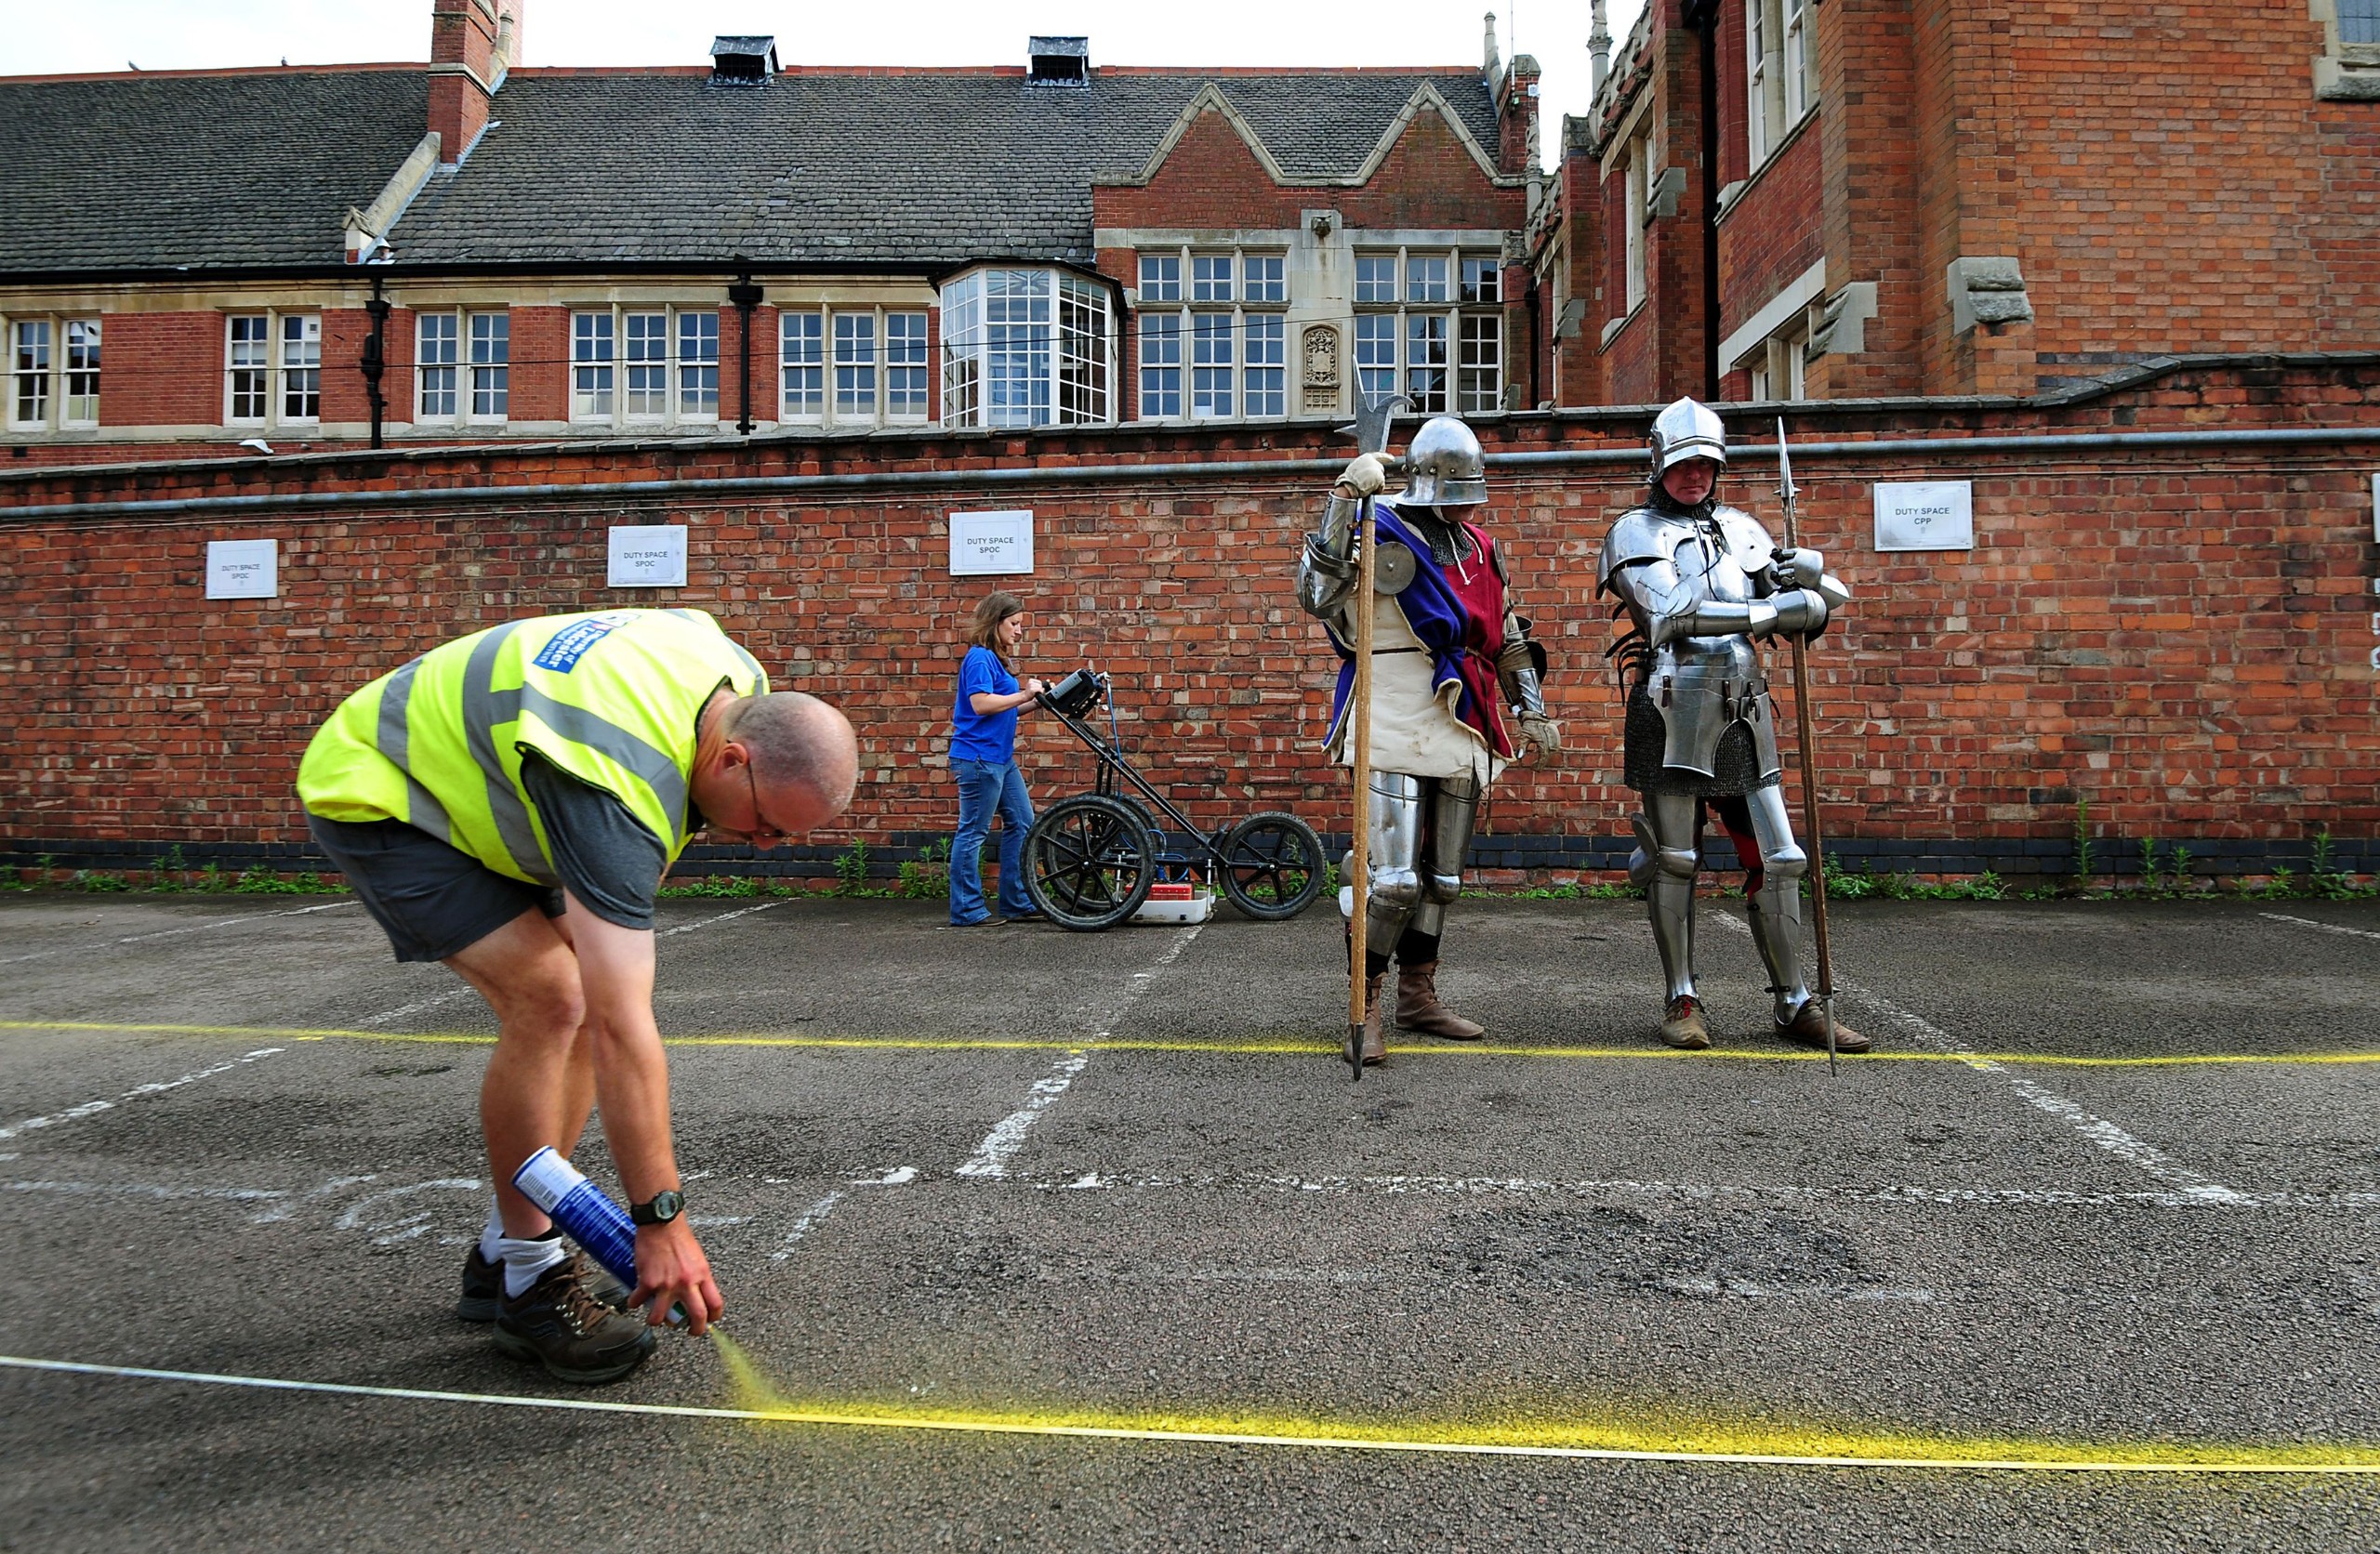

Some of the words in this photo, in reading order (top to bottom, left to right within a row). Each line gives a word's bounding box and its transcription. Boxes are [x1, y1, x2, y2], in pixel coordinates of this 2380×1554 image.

[1895, 507, 1919, 516] DUTY
[1921, 507, 1950, 515] SPACE
[988, 536, 1014, 545] SPACE
[644, 550, 668, 559] SPACE
